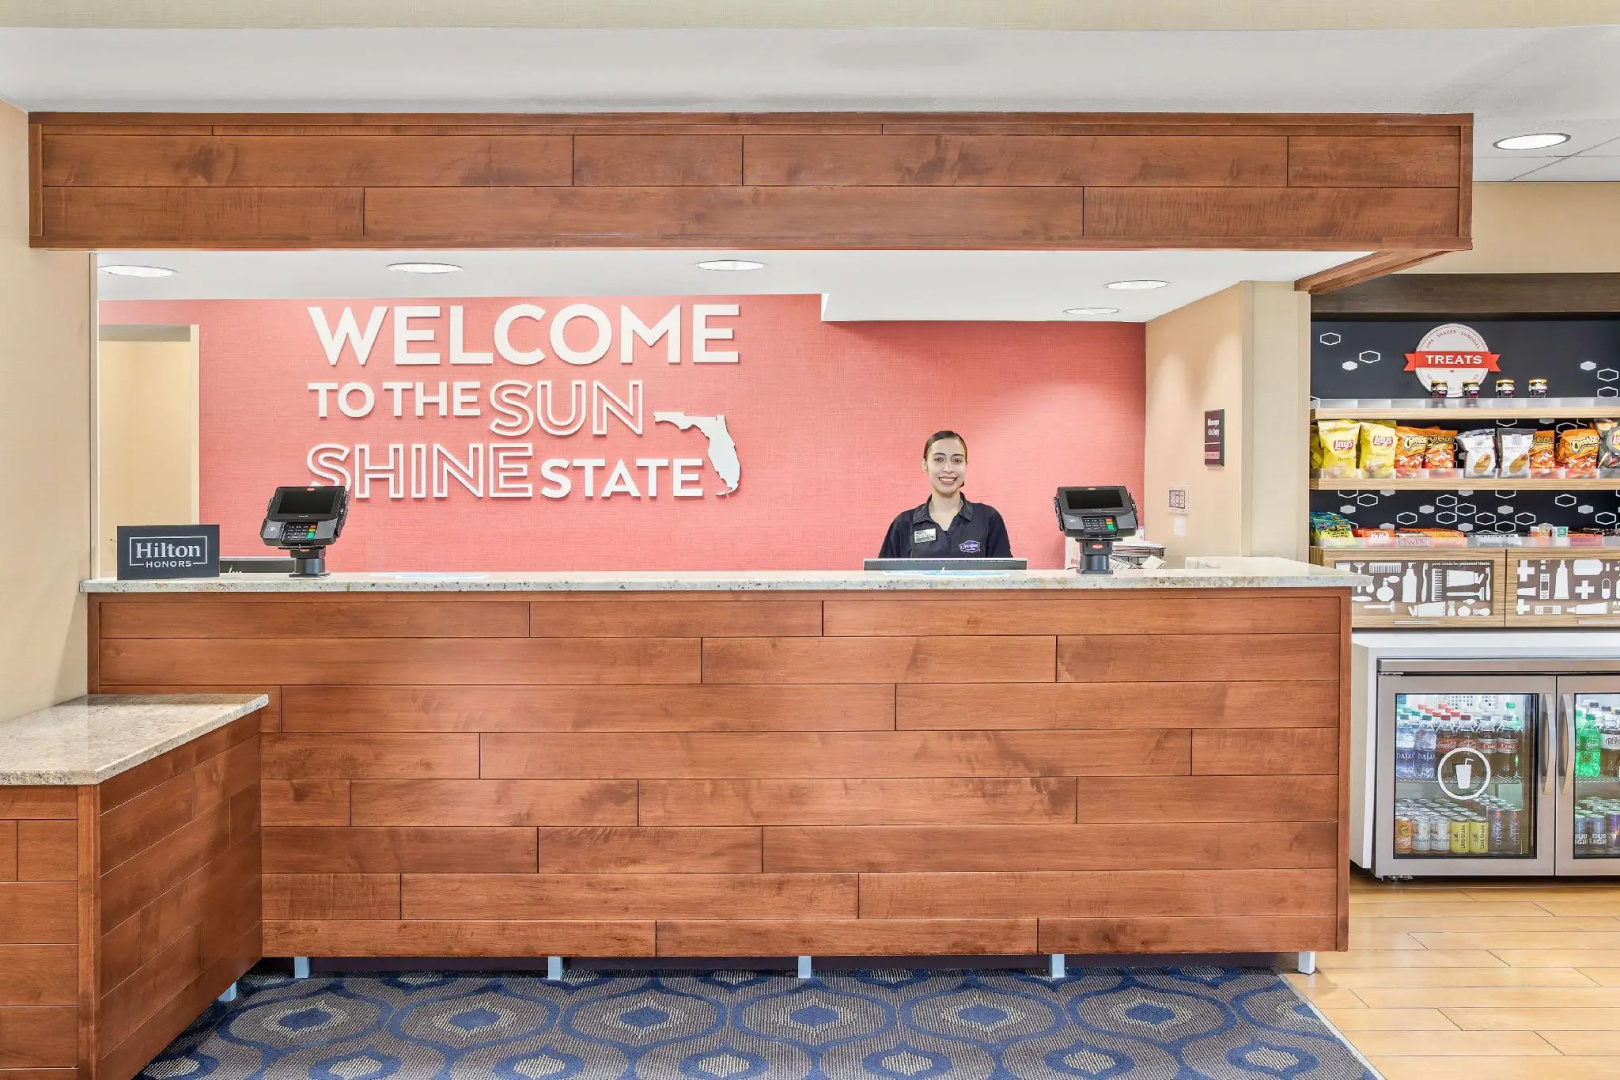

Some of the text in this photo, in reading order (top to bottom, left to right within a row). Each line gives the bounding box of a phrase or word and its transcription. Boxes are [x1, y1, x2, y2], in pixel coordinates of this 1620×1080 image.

[307, 304, 740, 366] WELCOME
[1425, 355, 1483, 365] TREATS
[307, 379, 644, 437] TO THE SUN
[306, 442, 704, 499] SHINE STATE
[135, 542, 201, 559] Hilton
[145, 560, 192, 568] HONORS
